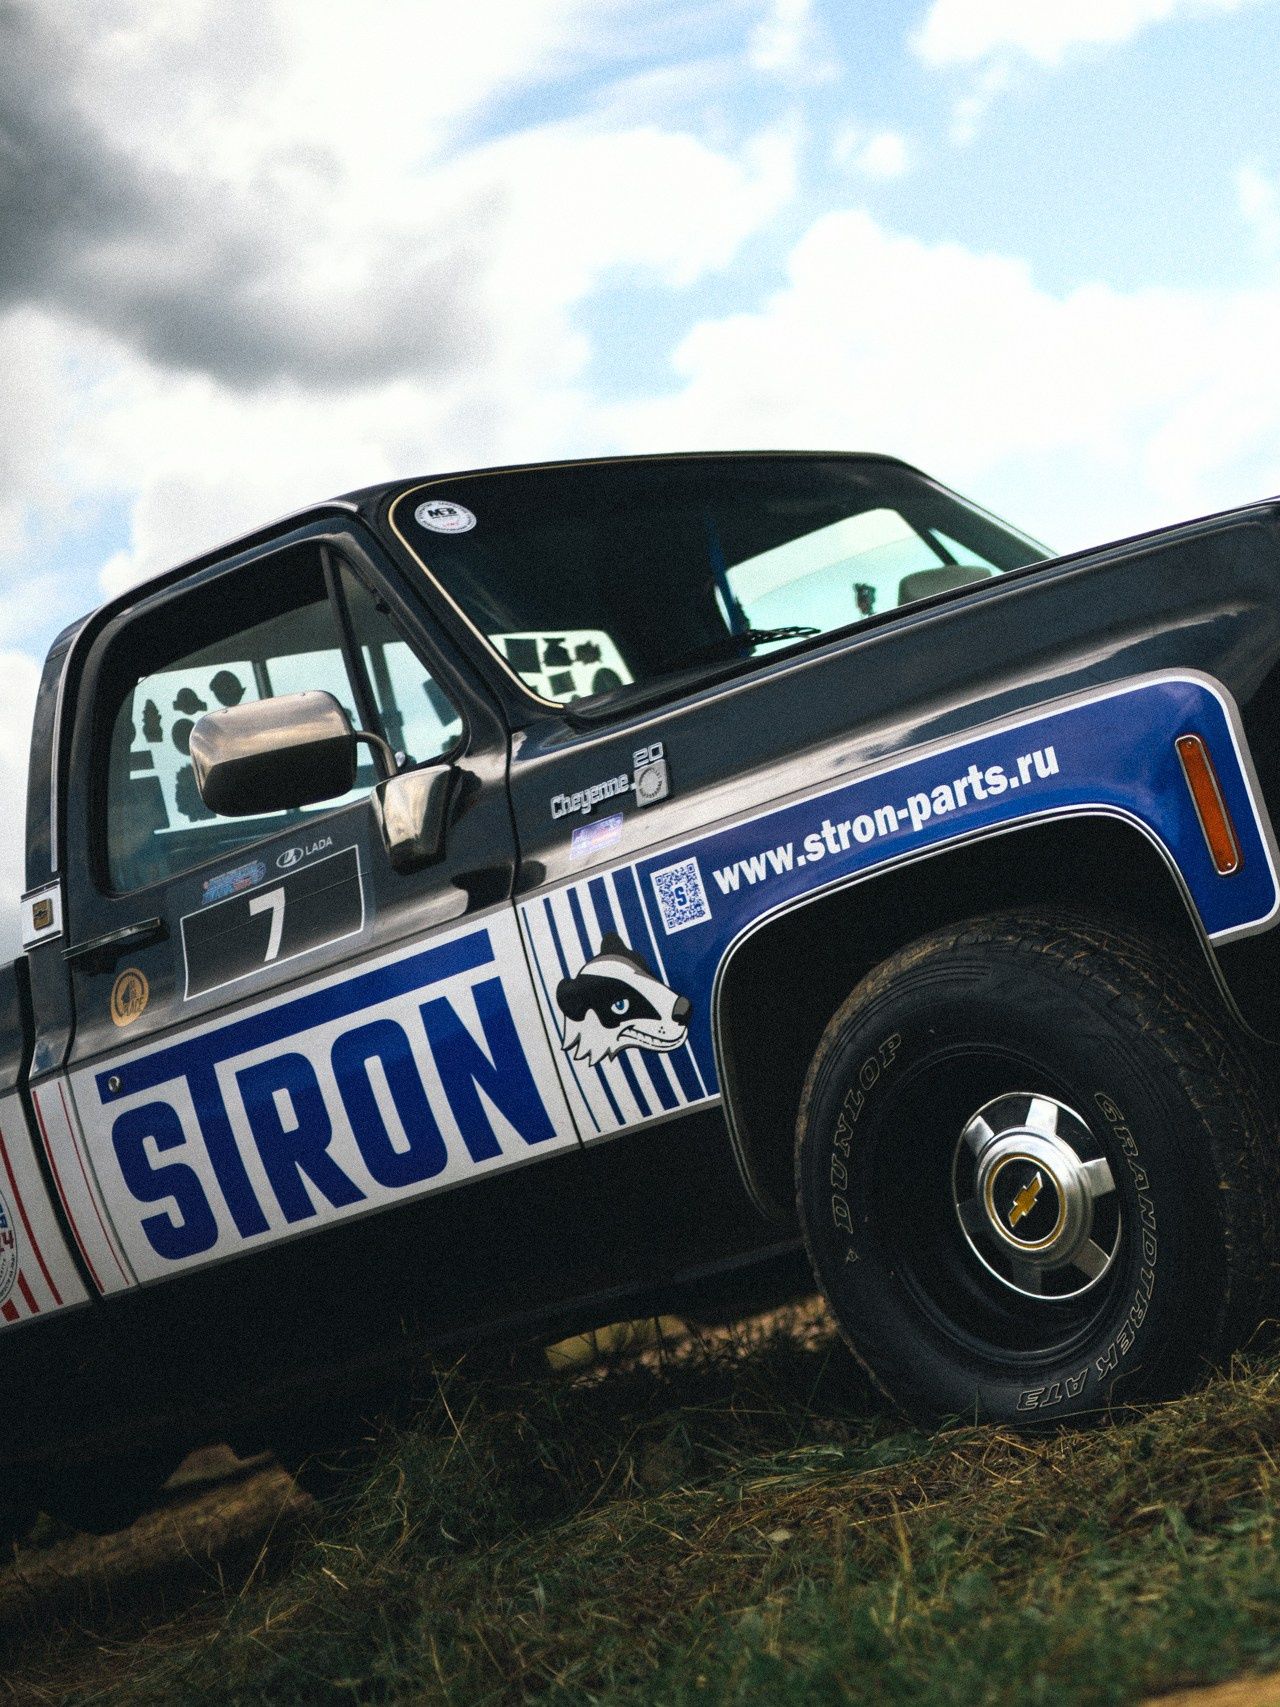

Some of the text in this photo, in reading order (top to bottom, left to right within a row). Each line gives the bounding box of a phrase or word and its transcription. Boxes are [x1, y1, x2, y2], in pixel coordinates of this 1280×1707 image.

[550, 773, 629, 820] Cheyenne
[632, 741, 664, 768] 20
[305, 836, 333, 856] LADA
[712, 745, 1061, 895] www.stron-parts.ru
[249, 887, 286, 962] 7
[94, 928, 558, 1261] STRON
[831, 1033, 901, 1235] DUNLOP
[1016, 1092, 1157, 1412] GRANDTREK AT3
